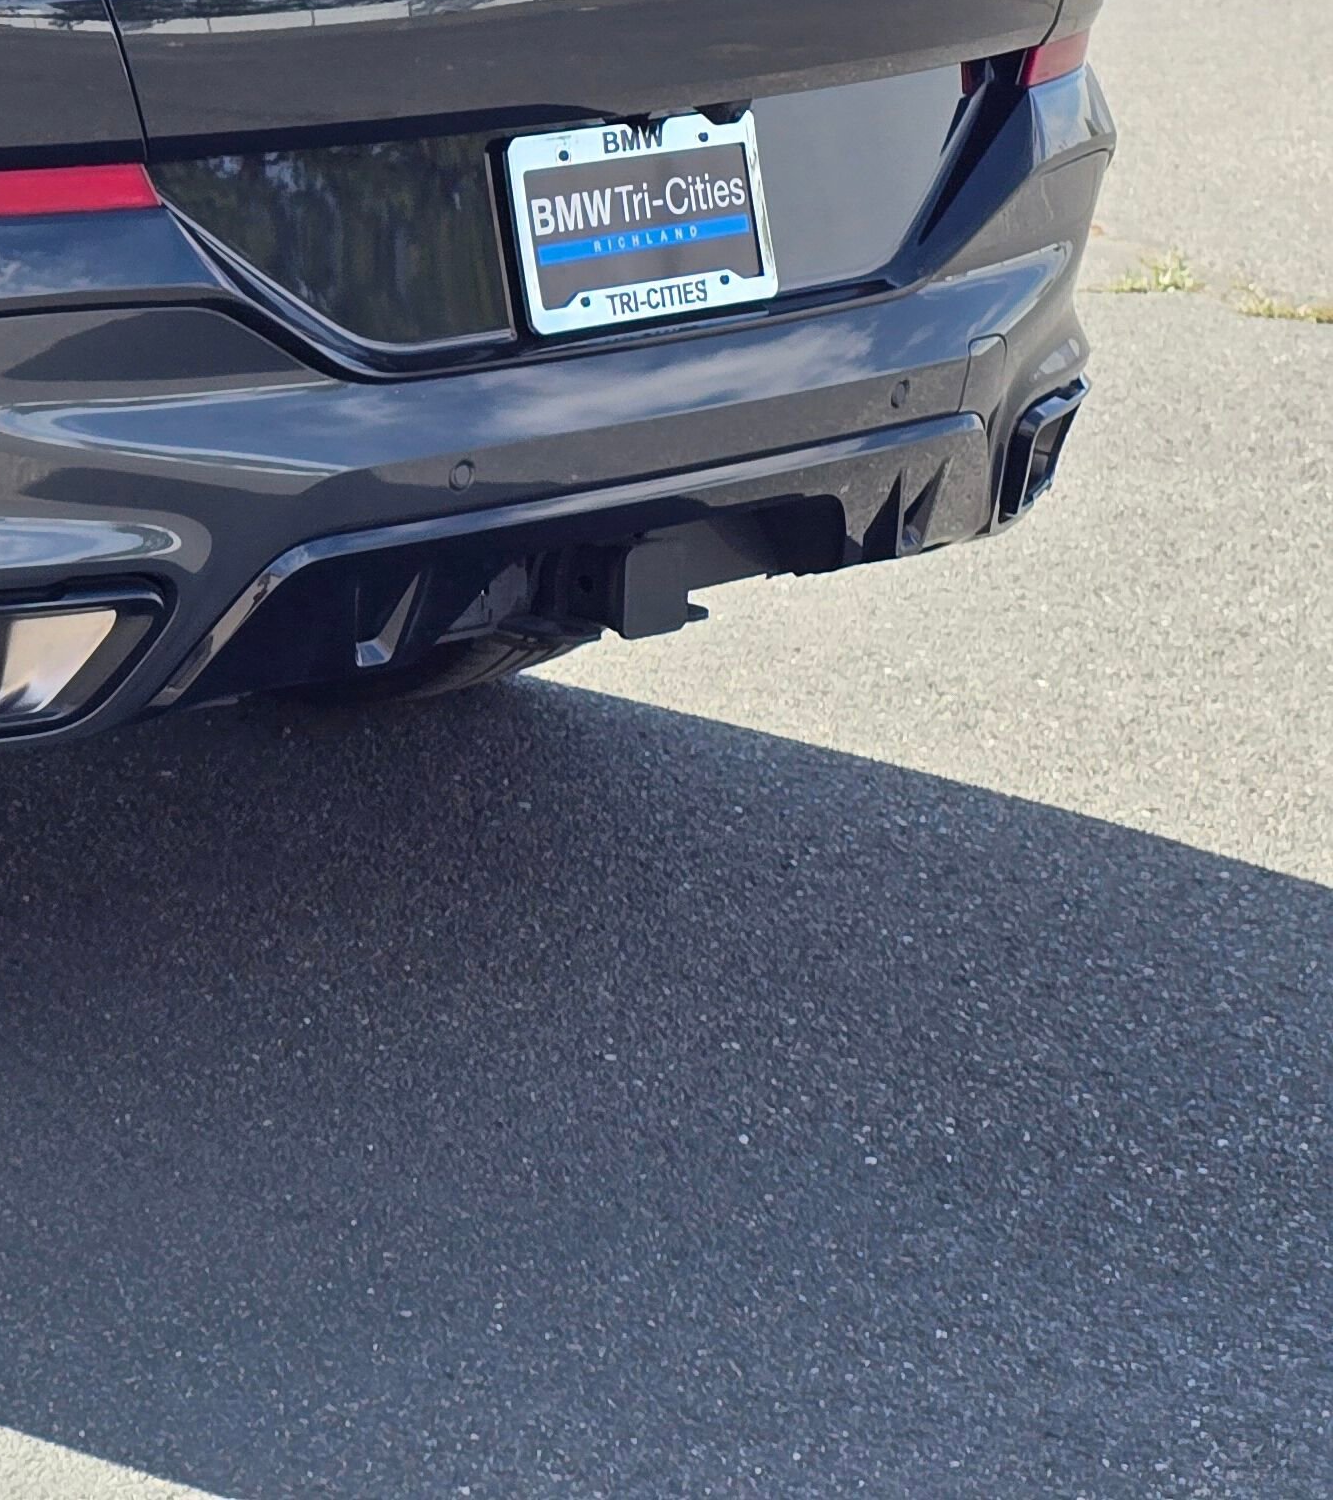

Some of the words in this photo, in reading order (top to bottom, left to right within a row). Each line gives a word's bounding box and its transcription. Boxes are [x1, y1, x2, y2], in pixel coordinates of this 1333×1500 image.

[602, 124, 663, 153] BMW
[531, 187, 612, 236] BMW
[614, 173, 745, 223] Tri-Cities
[593, 224, 699, 253] RICHLAND
[605, 279, 708, 317] TRI-CITIES
